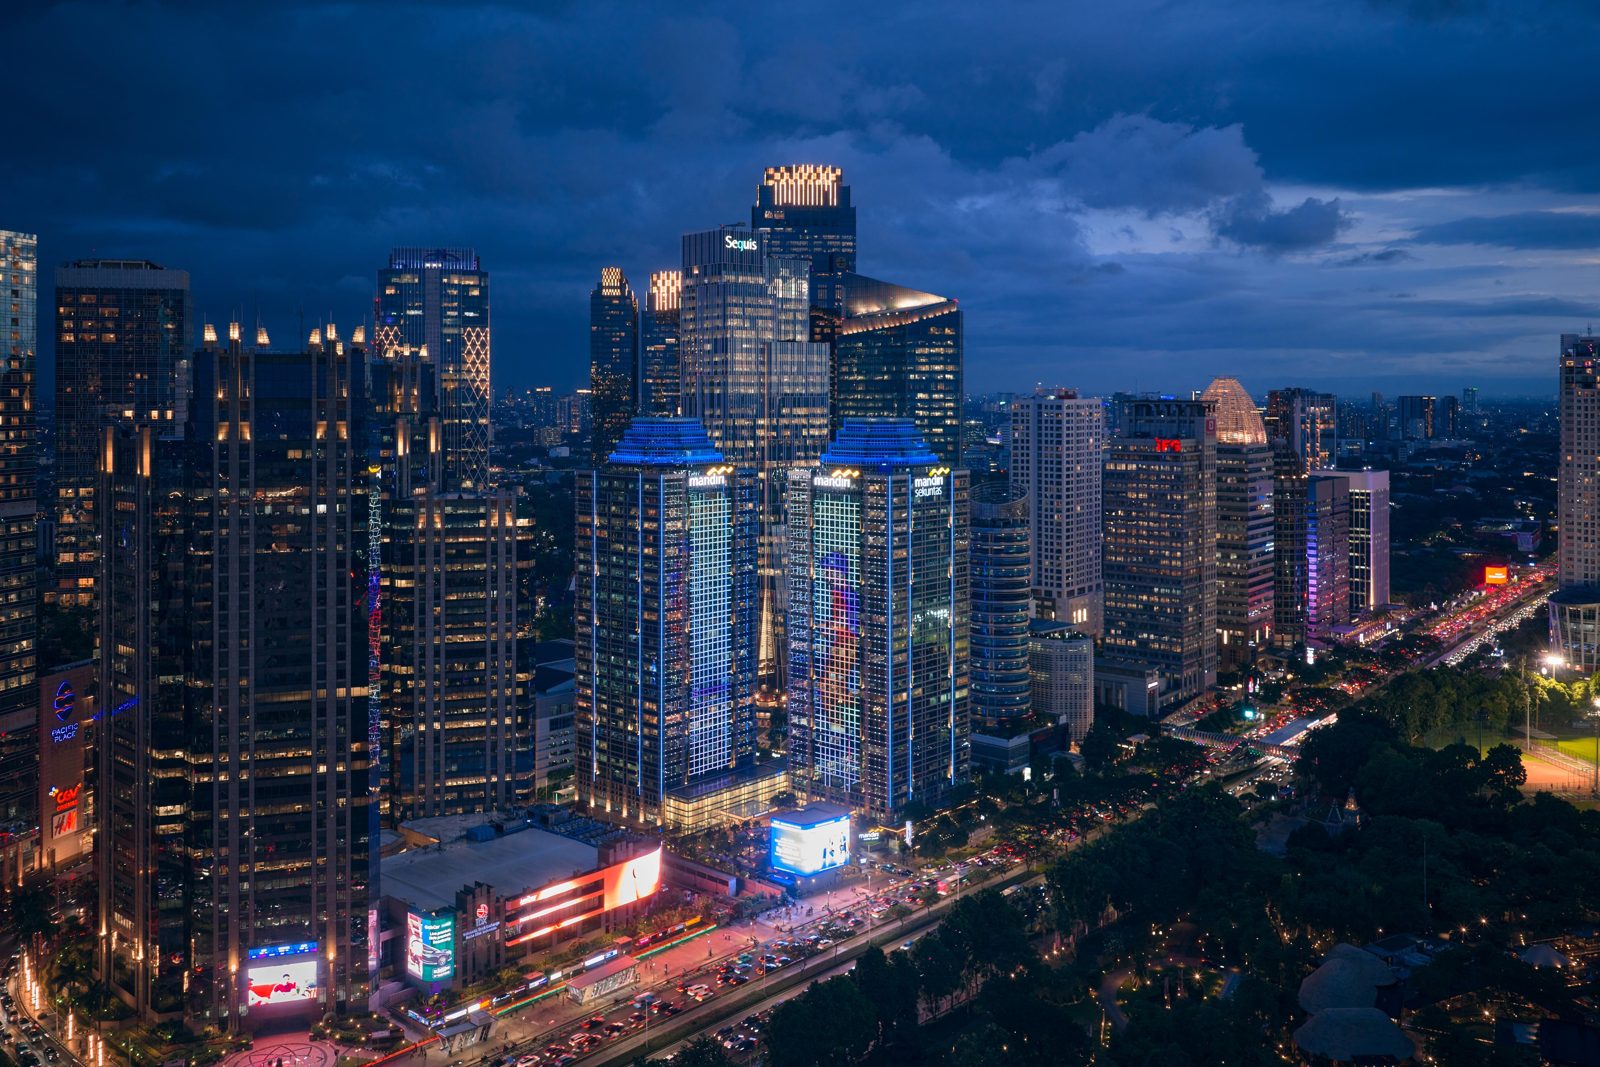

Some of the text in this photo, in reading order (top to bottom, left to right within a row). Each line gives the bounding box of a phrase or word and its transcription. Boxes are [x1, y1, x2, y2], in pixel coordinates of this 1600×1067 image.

[725, 235, 757, 252] Sequis
[689, 473, 724, 487] mandiri
[814, 475, 850, 488] mandiri
[51, 723, 78, 737] PACIFIC
[54, 731, 76, 743] PLACE
[57, 785, 80, 804] CGV
